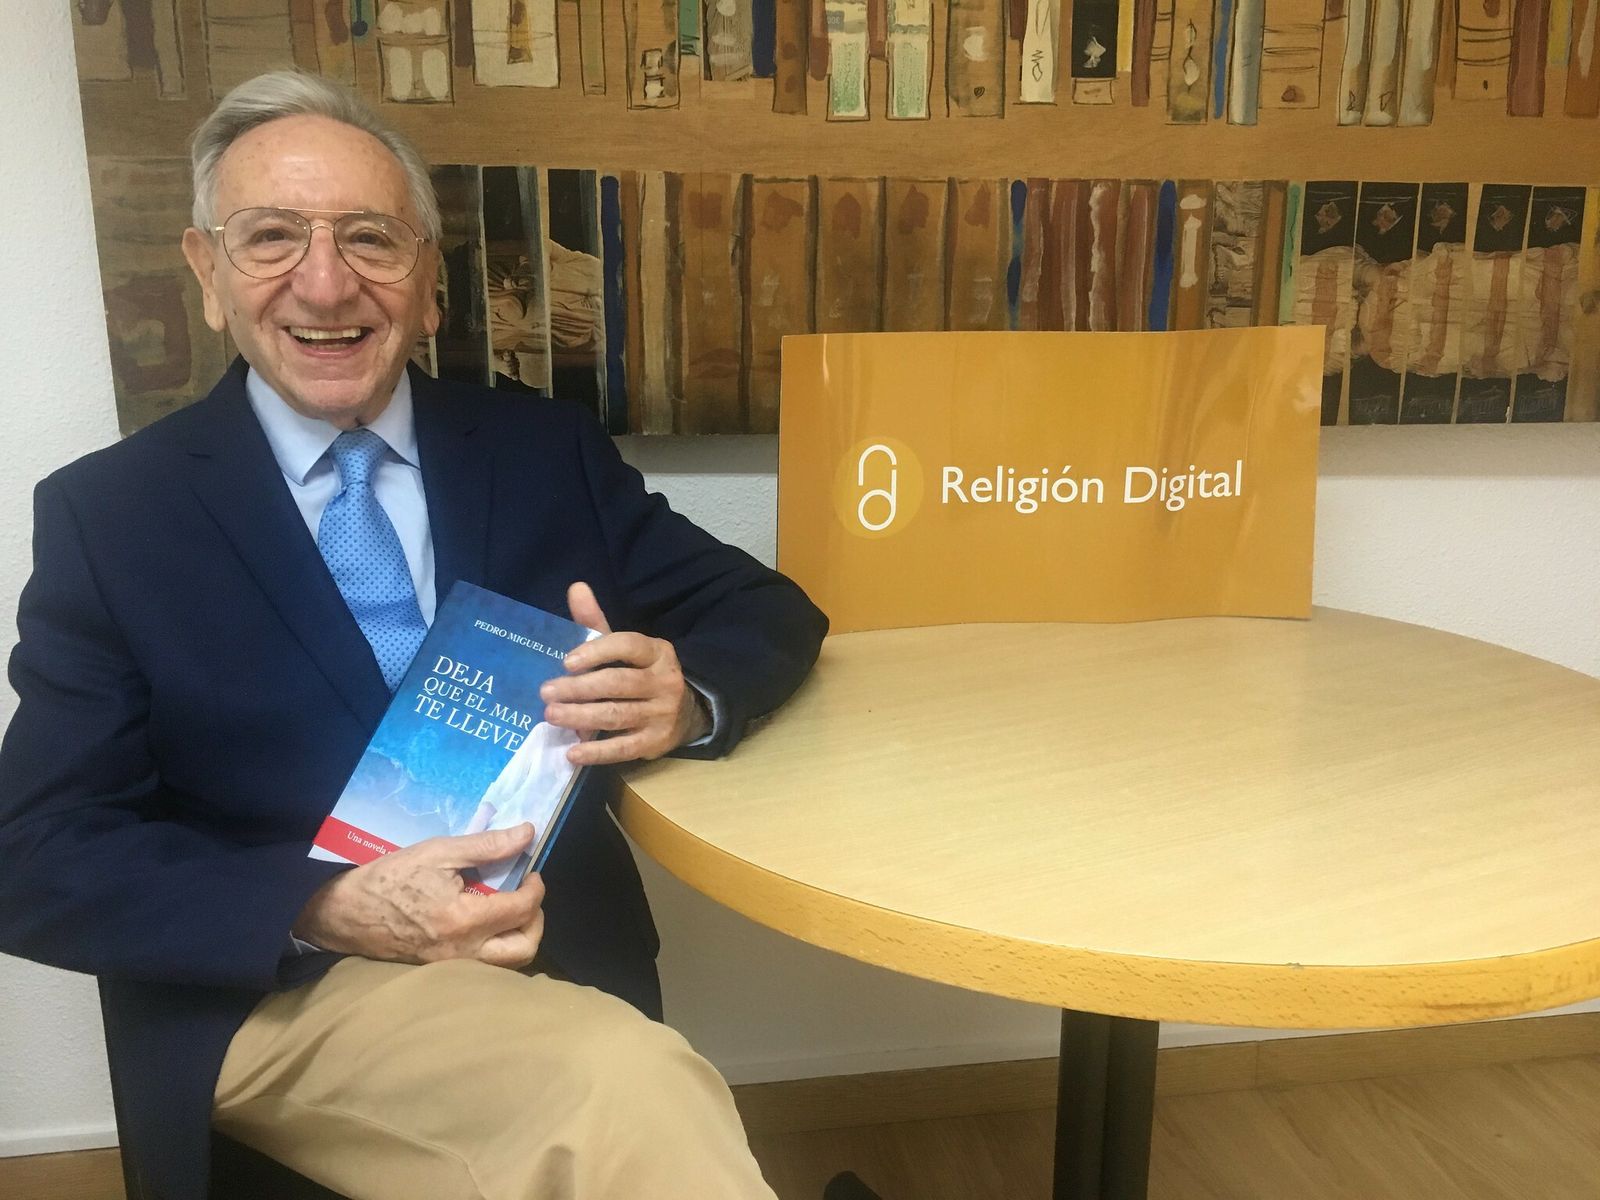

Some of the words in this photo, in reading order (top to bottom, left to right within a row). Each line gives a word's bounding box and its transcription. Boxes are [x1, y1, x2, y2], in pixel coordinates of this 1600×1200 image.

[941, 464, 1104, 514] Religión
[1123, 459, 1243, 512] Digital
[474, 619, 507, 638] PEDRO
[507, 632, 545, 653] MIGUEL
[546, 647, 568, 660] LAM
[432, 655, 495, 695] DEJA
[414, 693, 445, 720] TE
[445, 707, 524, 753] LLEVE
[423, 677, 464, 703] QUE
[464, 692, 488, 713] EL
[489, 702, 532, 731] MAR
[347, 830, 362, 844] Una
[362, 841, 387, 856] novela
